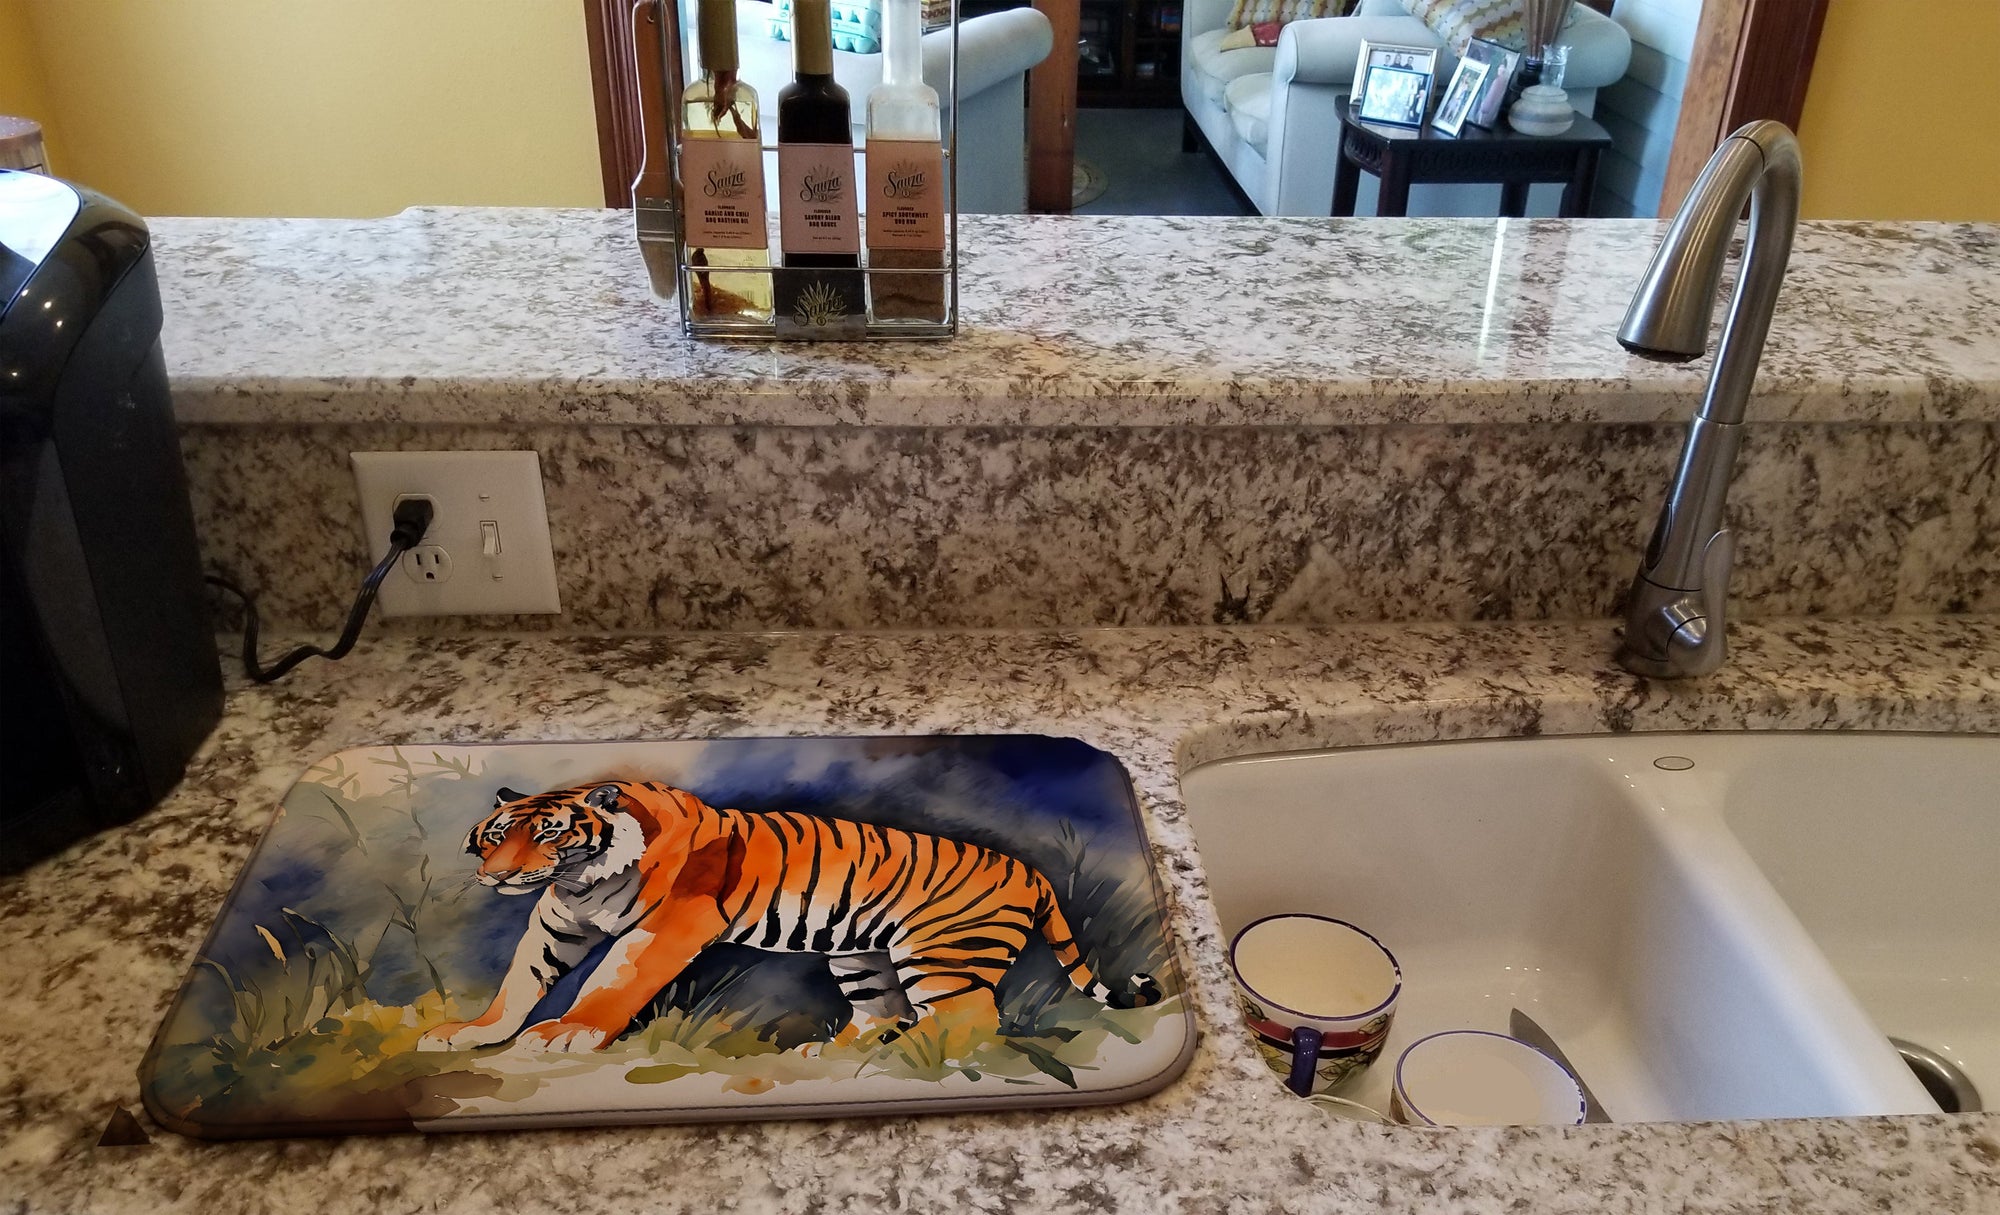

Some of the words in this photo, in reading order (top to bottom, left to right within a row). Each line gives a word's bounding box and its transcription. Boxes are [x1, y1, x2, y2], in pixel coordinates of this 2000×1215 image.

[703, 170, 746, 197] Sauza
[800, 175, 841, 202] Sauza
[883, 171, 925, 198] Sauza
[793, 295, 843, 326] Sauza
